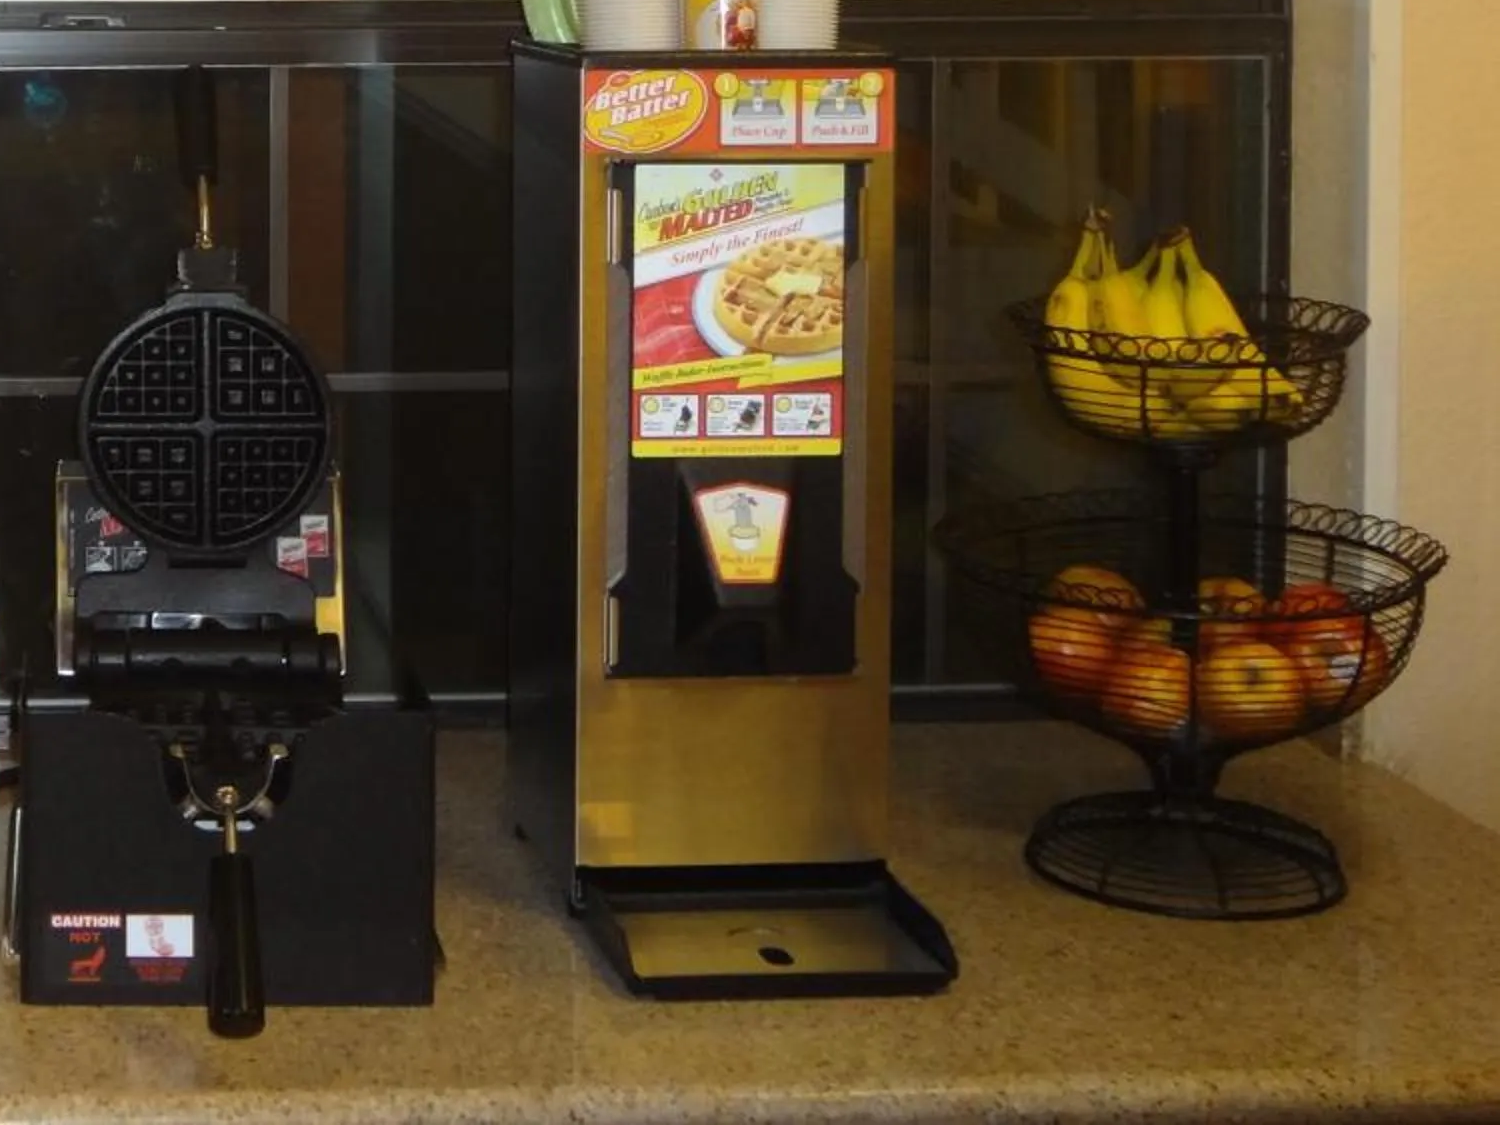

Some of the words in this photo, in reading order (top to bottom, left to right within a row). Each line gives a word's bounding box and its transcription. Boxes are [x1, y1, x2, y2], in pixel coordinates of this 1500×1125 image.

[596, 76, 676, 111] Better
[611, 91, 690, 125] Batter
[763, 125, 787, 139] Cup
[658, 198, 755, 242] MALTED
[671, 241, 723, 266] Simply
[727, 234, 751, 252] the
[754, 218, 804, 244] Finest!
[51, 914, 121, 928] CAUTION
[69, 932, 102, 943] HOT
